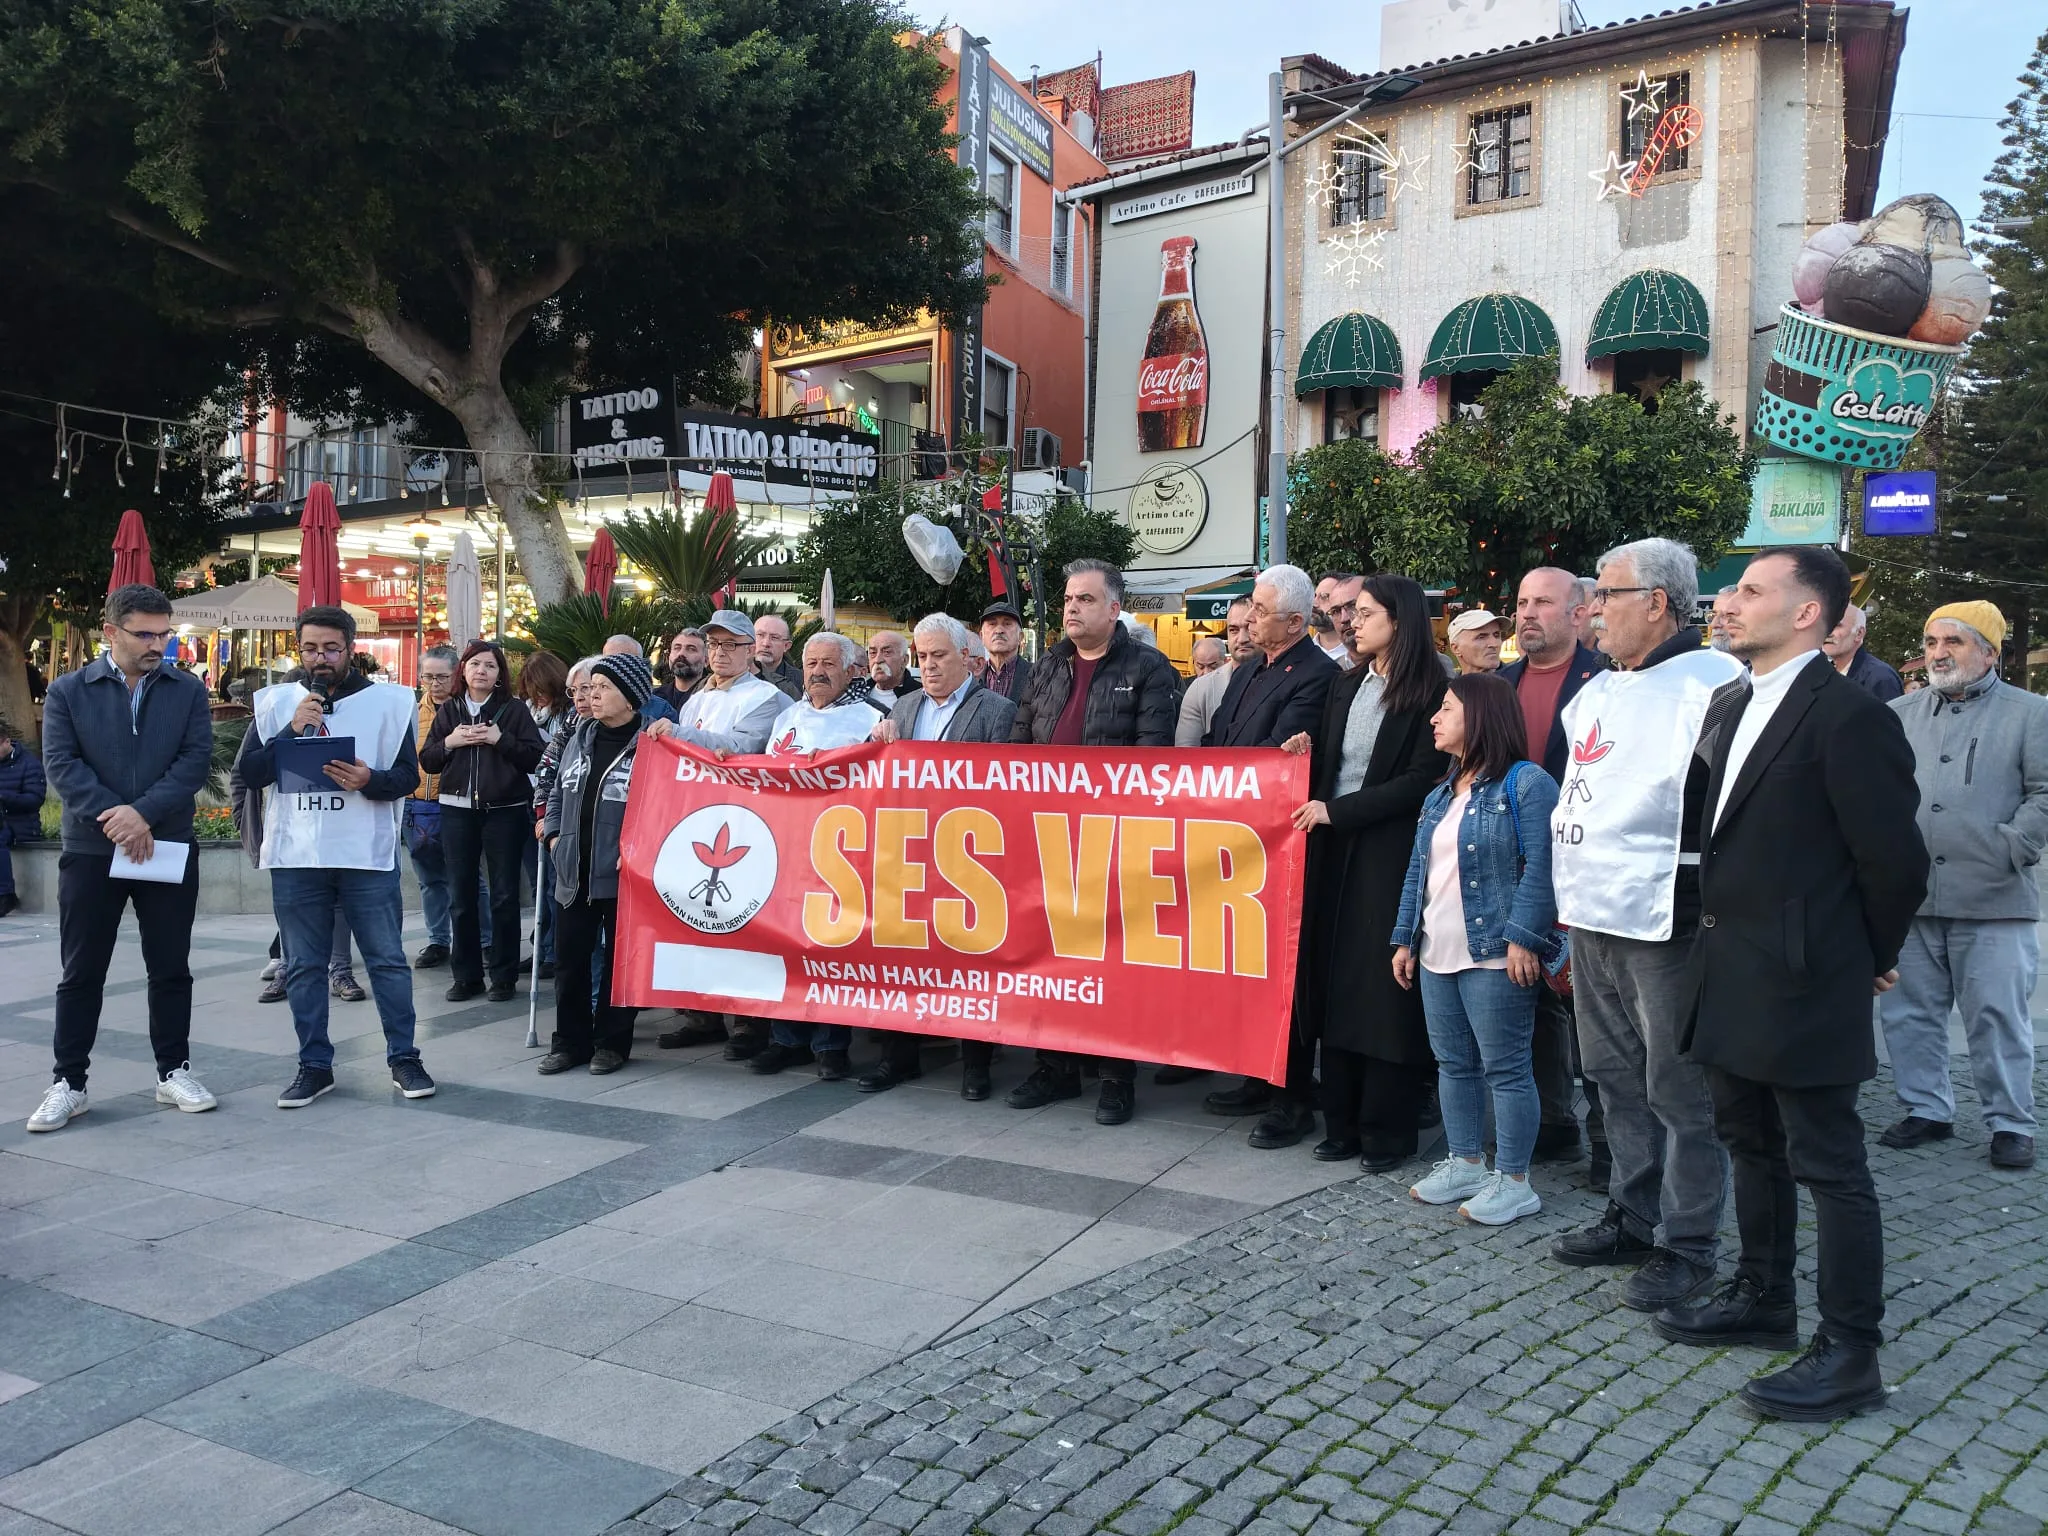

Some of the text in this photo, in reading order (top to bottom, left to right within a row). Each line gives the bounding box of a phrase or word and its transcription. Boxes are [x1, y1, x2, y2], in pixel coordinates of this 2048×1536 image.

[1115, 202, 1156, 217] Artimo
[1160, 194, 1187, 207] Cafe
[581, 387, 659, 420] TATTOO
[611, 418, 628, 439] &
[684, 422, 769, 466] TATTOO
[772, 434, 789, 468] &
[1136, 509, 1195, 520] Artimo Cafe
[1769, 501, 1825, 518] BAKLAVA
[237, 614, 297, 623] LA GELATER
[675, 755, 791, 795] BARIŞA,
[789, 759, 884, 791] İNSAN
[892, 759, 1103, 799] HAKLARINA,
[1103, 763, 1263, 806] YAŞAMA
[802, 804, 1268, 979] SES VER
[662, 892, 761, 931] İNSAN HAKLARI DERNEĞİ
[703, 909, 718, 919] 1986
[801, 955, 1104, 1005] İNSAN HAKLARI DERNEĞİ
[804, 982, 999, 1022] ANTALYA ŞUBESİ
